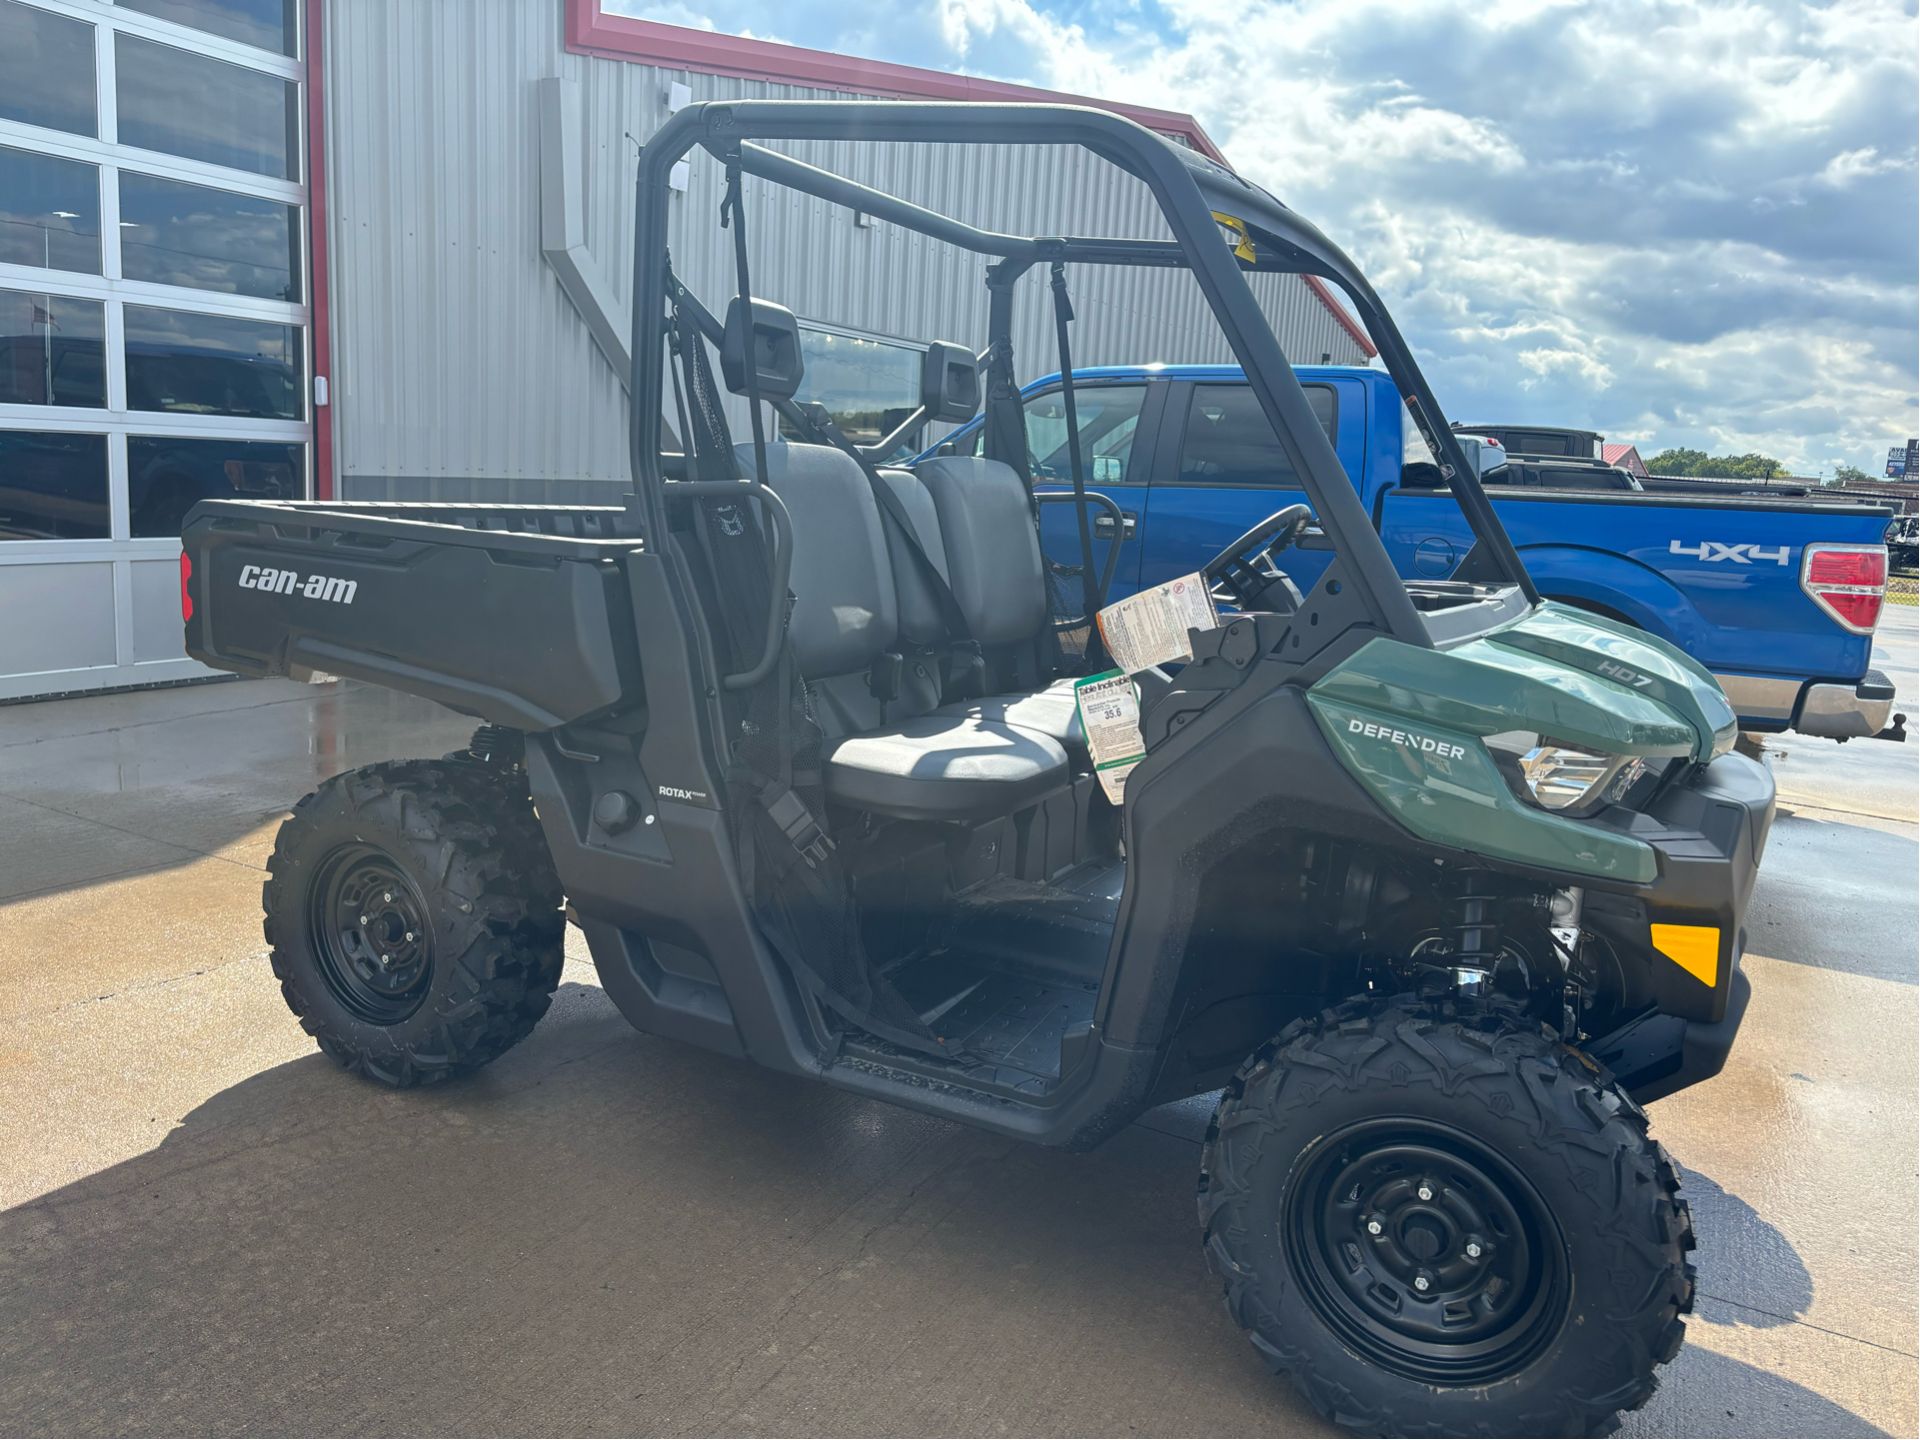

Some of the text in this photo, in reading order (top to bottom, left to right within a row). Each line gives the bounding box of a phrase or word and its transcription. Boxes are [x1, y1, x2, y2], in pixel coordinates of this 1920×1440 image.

[239, 565, 357, 604] can-am
[1597, 660, 1652, 687] HD7
[1104, 708, 1122, 720] 35.6
[1348, 719, 1465, 760] DEFENDER
[659, 786, 692, 800] ROTAX
